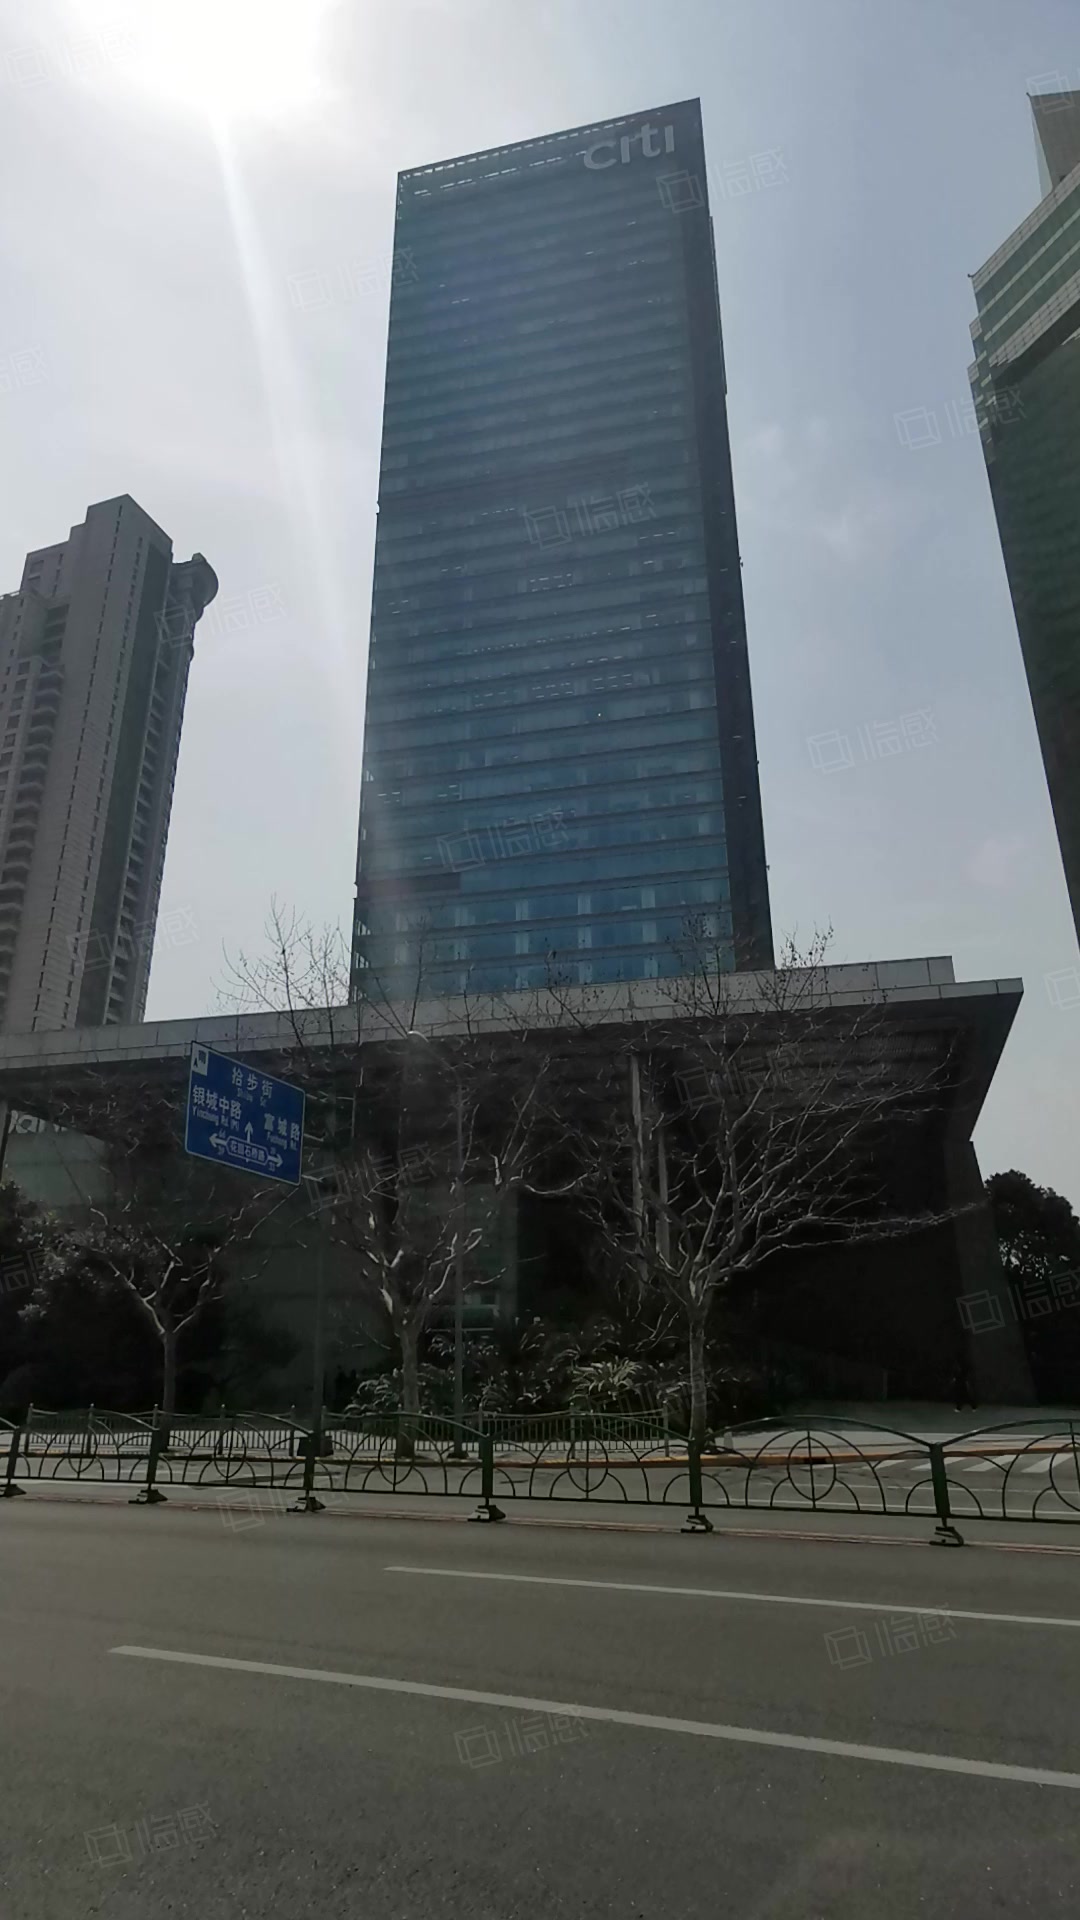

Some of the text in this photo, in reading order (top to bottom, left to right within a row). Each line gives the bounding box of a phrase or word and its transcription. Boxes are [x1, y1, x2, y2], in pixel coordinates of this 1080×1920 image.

[583, 122, 675, 170] citi
[232, 1067, 273, 1098] 拾步街
[193, 1085, 241, 1119] 银城中路
[264, 1113, 300, 1142] 富城路
